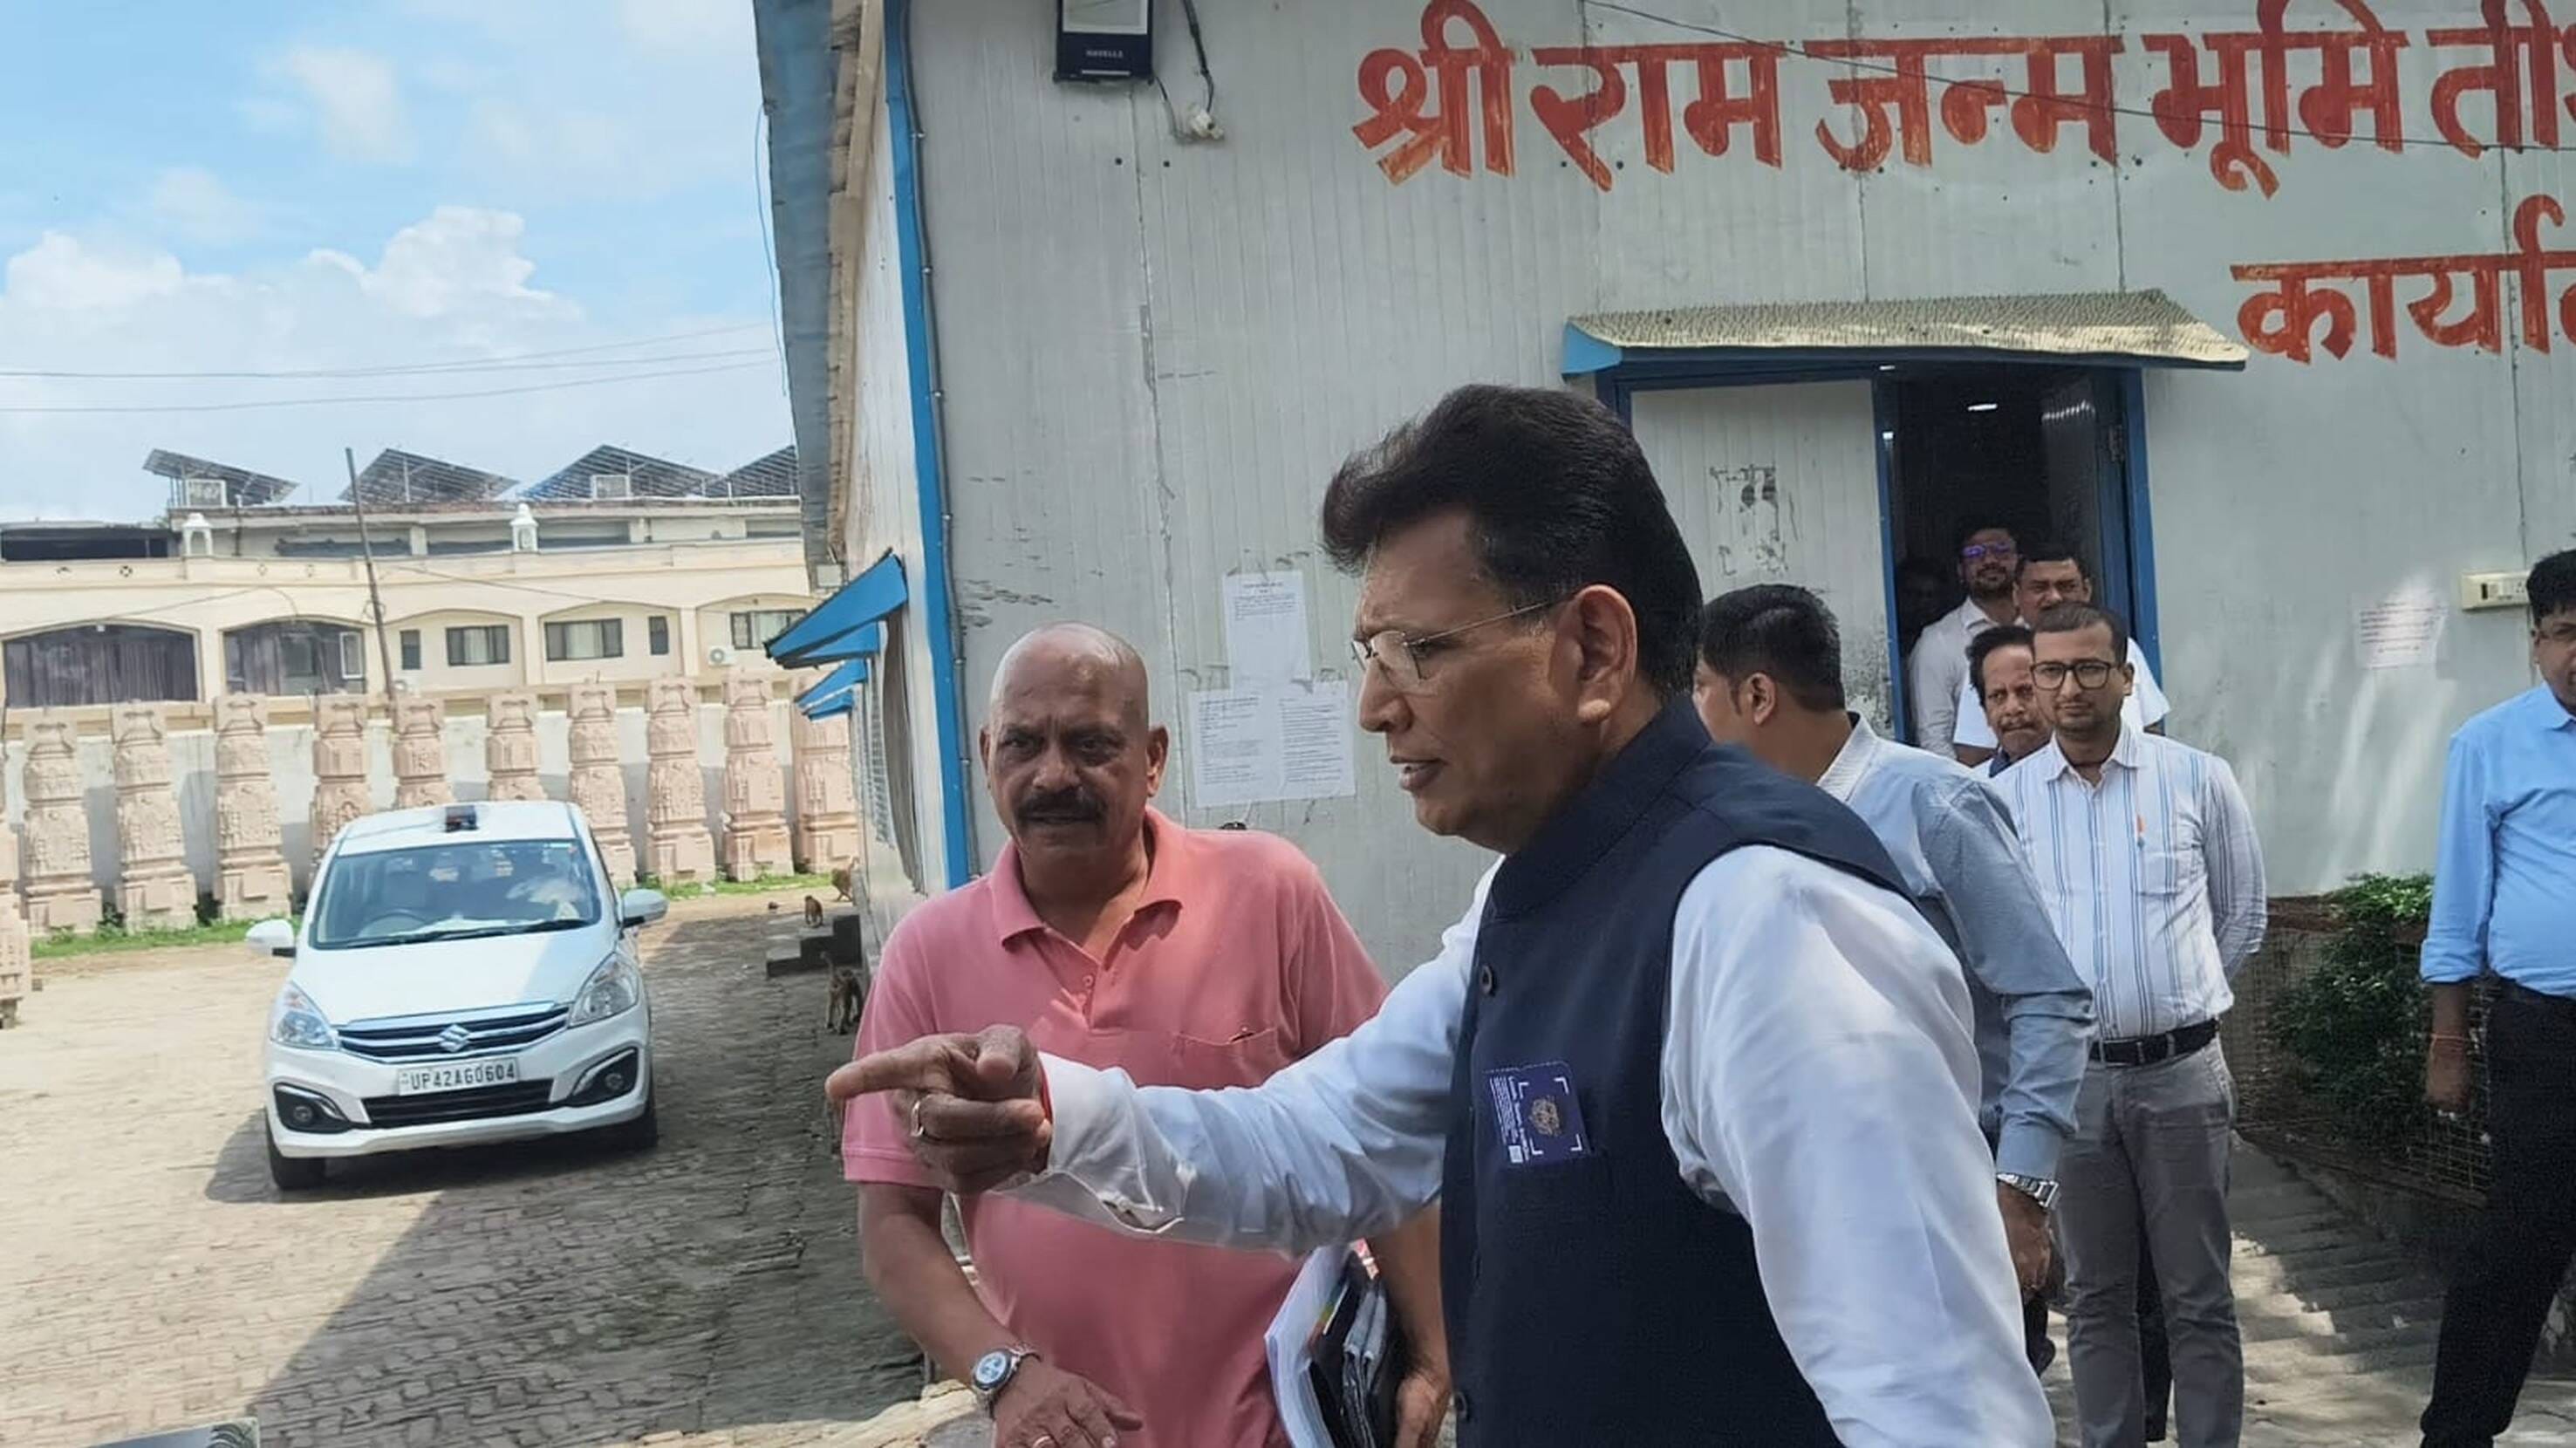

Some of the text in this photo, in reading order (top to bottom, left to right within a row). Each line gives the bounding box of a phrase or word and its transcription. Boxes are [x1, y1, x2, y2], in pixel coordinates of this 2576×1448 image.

[1352, 0, 2576, 199] श्री राम जन्म भूमि ती
[2230, 194, 2576, 363] कार्या
[410, 1062, 516, 1090] UP42AG0604
